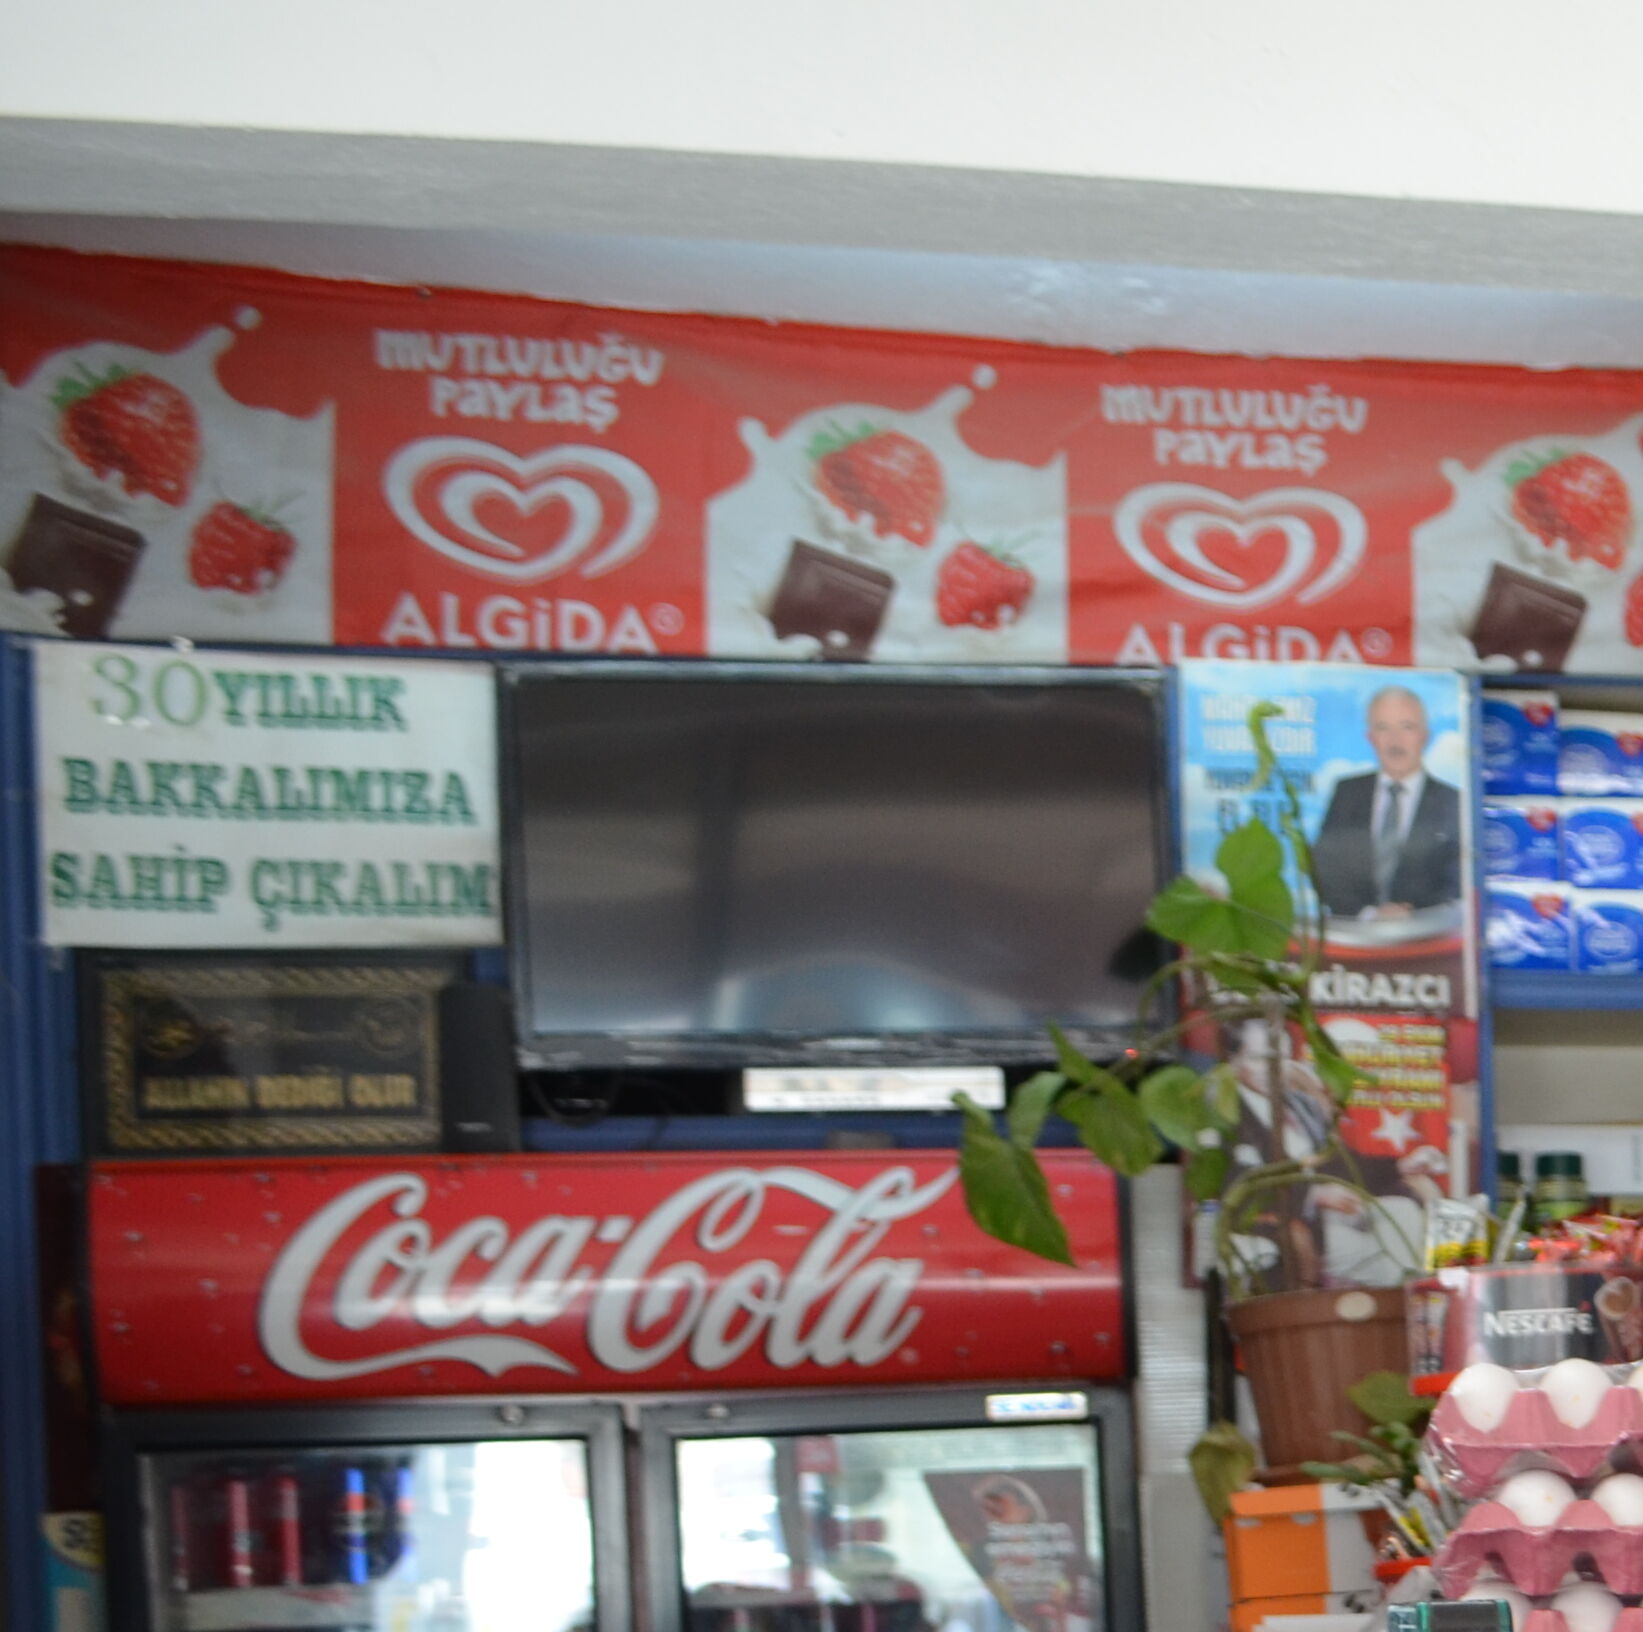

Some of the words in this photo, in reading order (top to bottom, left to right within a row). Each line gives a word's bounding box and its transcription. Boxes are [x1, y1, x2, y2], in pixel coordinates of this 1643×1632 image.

[212, 669, 408, 733] YILLIK
[59, 755, 480, 826] BAKKALIMIZA
[50, 842, 231, 915] SAHİP
[250, 854, 492, 932] ÇIKALIM
[259, 1165, 963, 1382] Coca-Cola
